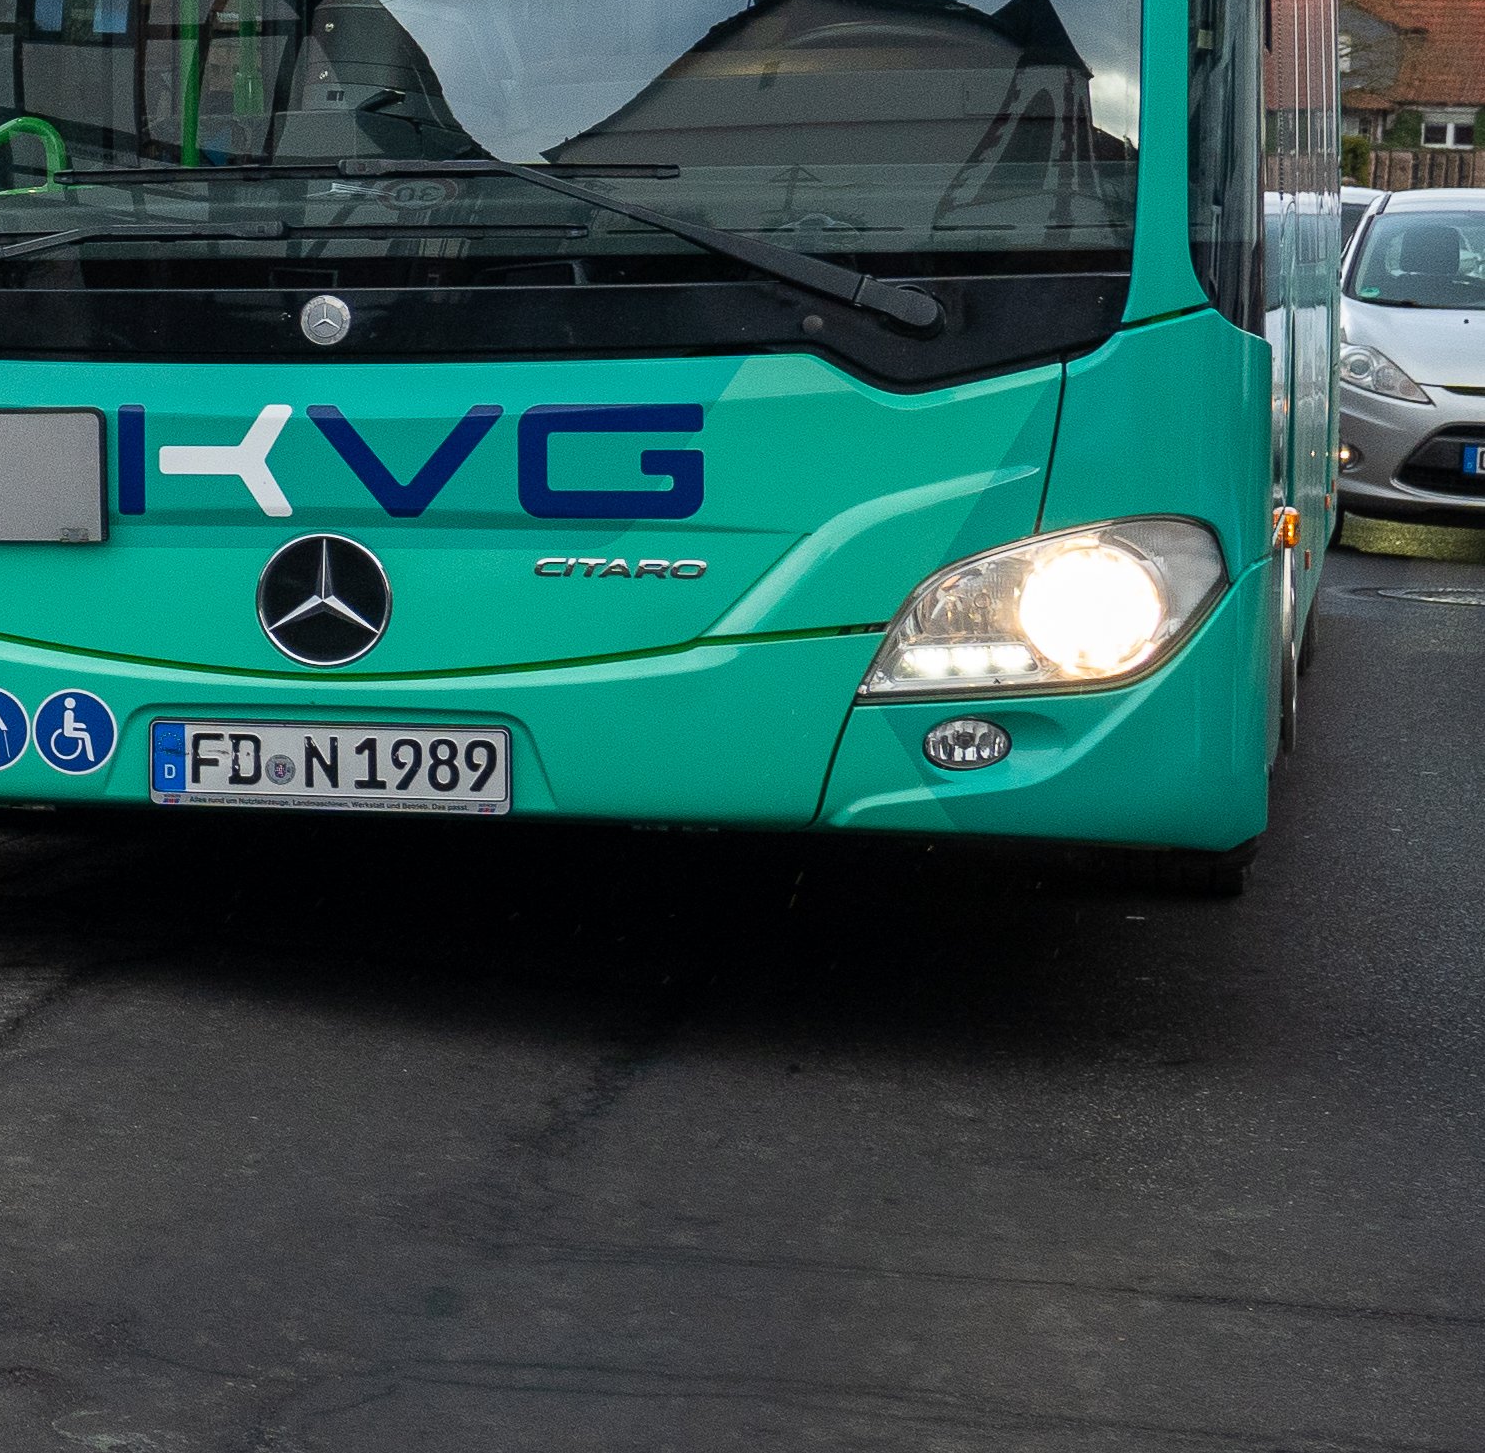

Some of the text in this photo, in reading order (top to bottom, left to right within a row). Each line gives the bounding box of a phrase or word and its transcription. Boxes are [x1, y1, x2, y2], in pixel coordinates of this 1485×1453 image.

[118, 404, 704, 519] KVG
[534, 558, 708, 579] CITARO
[164, 764, 177, 779] D
[191, 732, 262, 785] FD
